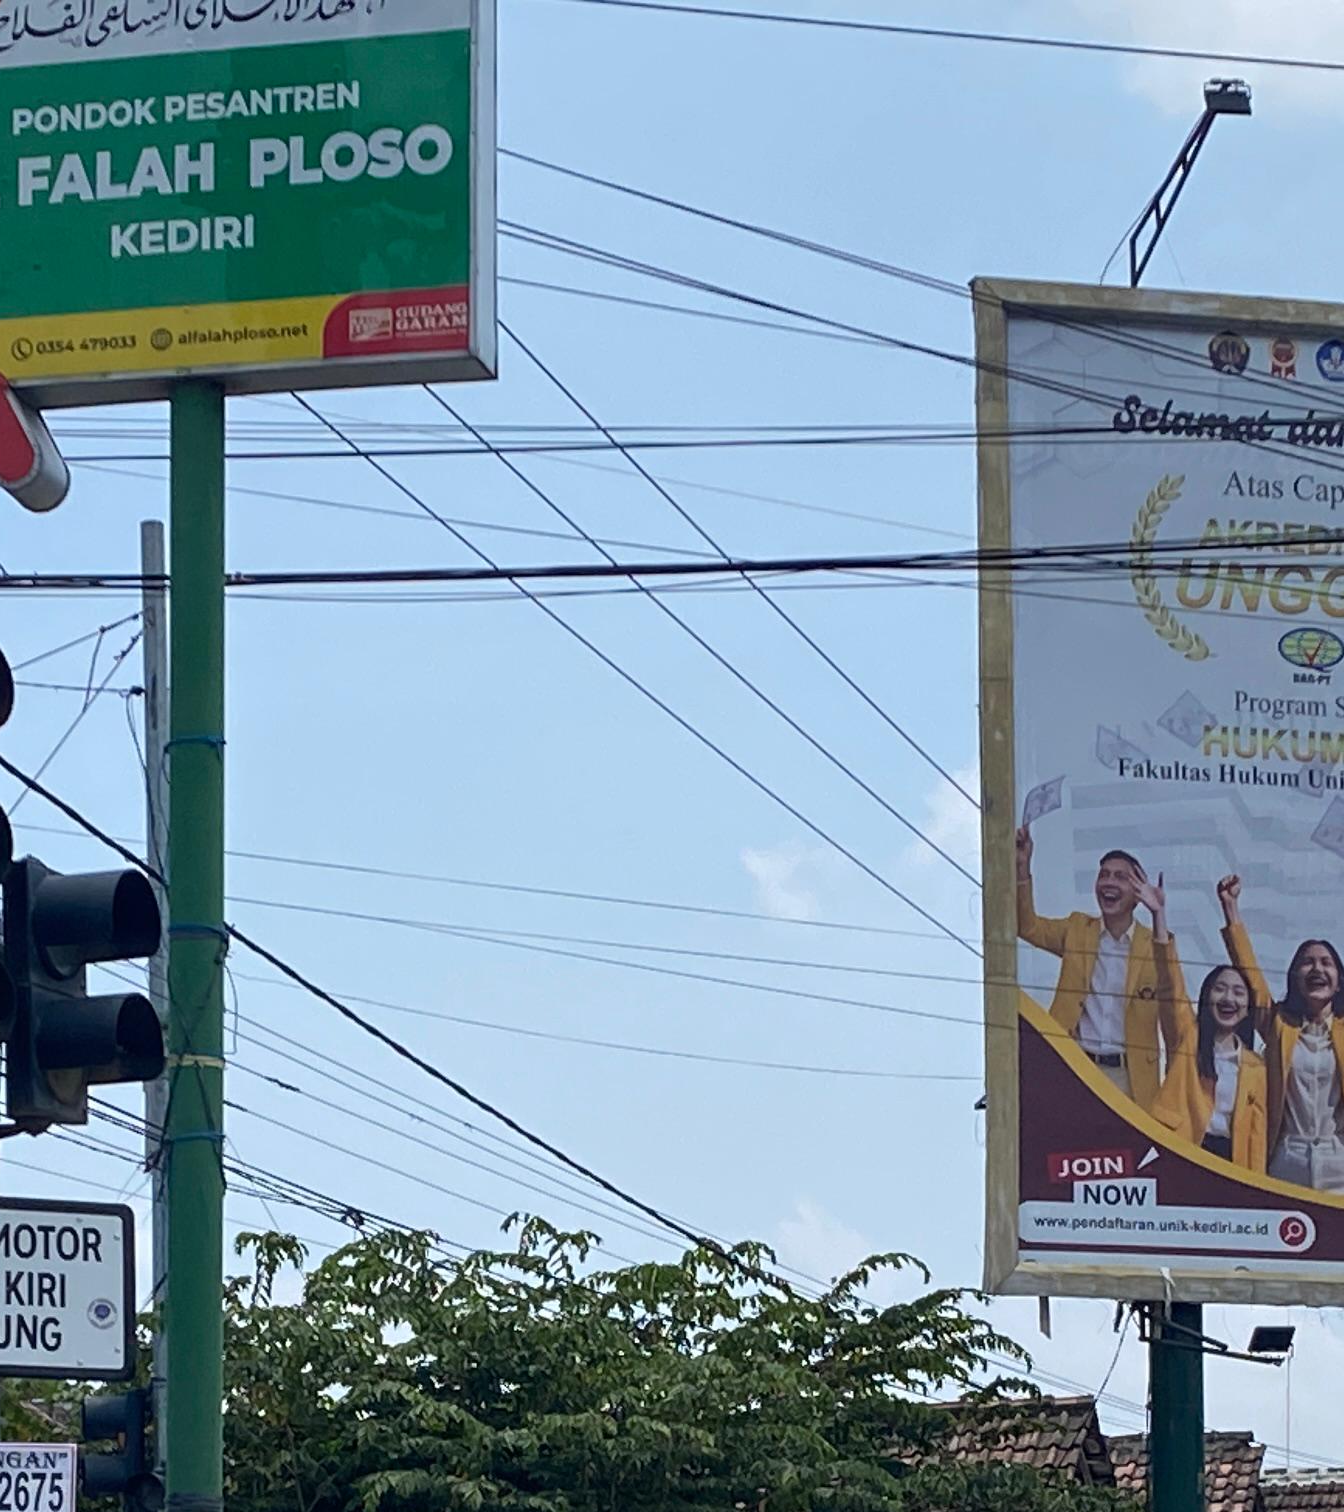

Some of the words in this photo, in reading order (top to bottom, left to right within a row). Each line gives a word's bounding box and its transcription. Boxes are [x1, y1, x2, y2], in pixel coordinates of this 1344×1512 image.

[13, 96, 154, 136] PONDOK
[164, 81, 360, 121] PESANTREN
[18, 142, 215, 206] FALAH
[251, 124, 453, 188] PLOSO
[111, 214, 254, 257] KEDIRI
[395, 301, 467, 318] GUDANG
[396, 314, 467, 330] GARAM
[36, 338, 74, 355] 0354
[79, 334, 137, 353] 479033
[178, 322, 309, 347] alfalahploso.net
[1113, 395, 1274, 440] Selamat
[1223, 470, 1284, 500] Atas
[1234, 690, 1327, 721] Program
[1118, 757, 1211, 783] Fakultas
[1218, 764, 1299, 788] Hukum
[1058, 1155, 1124, 1178] JOIN
[1083, 1183, 1147, 1206] NOW
[6, 1271, 66, 1309] KIRI
